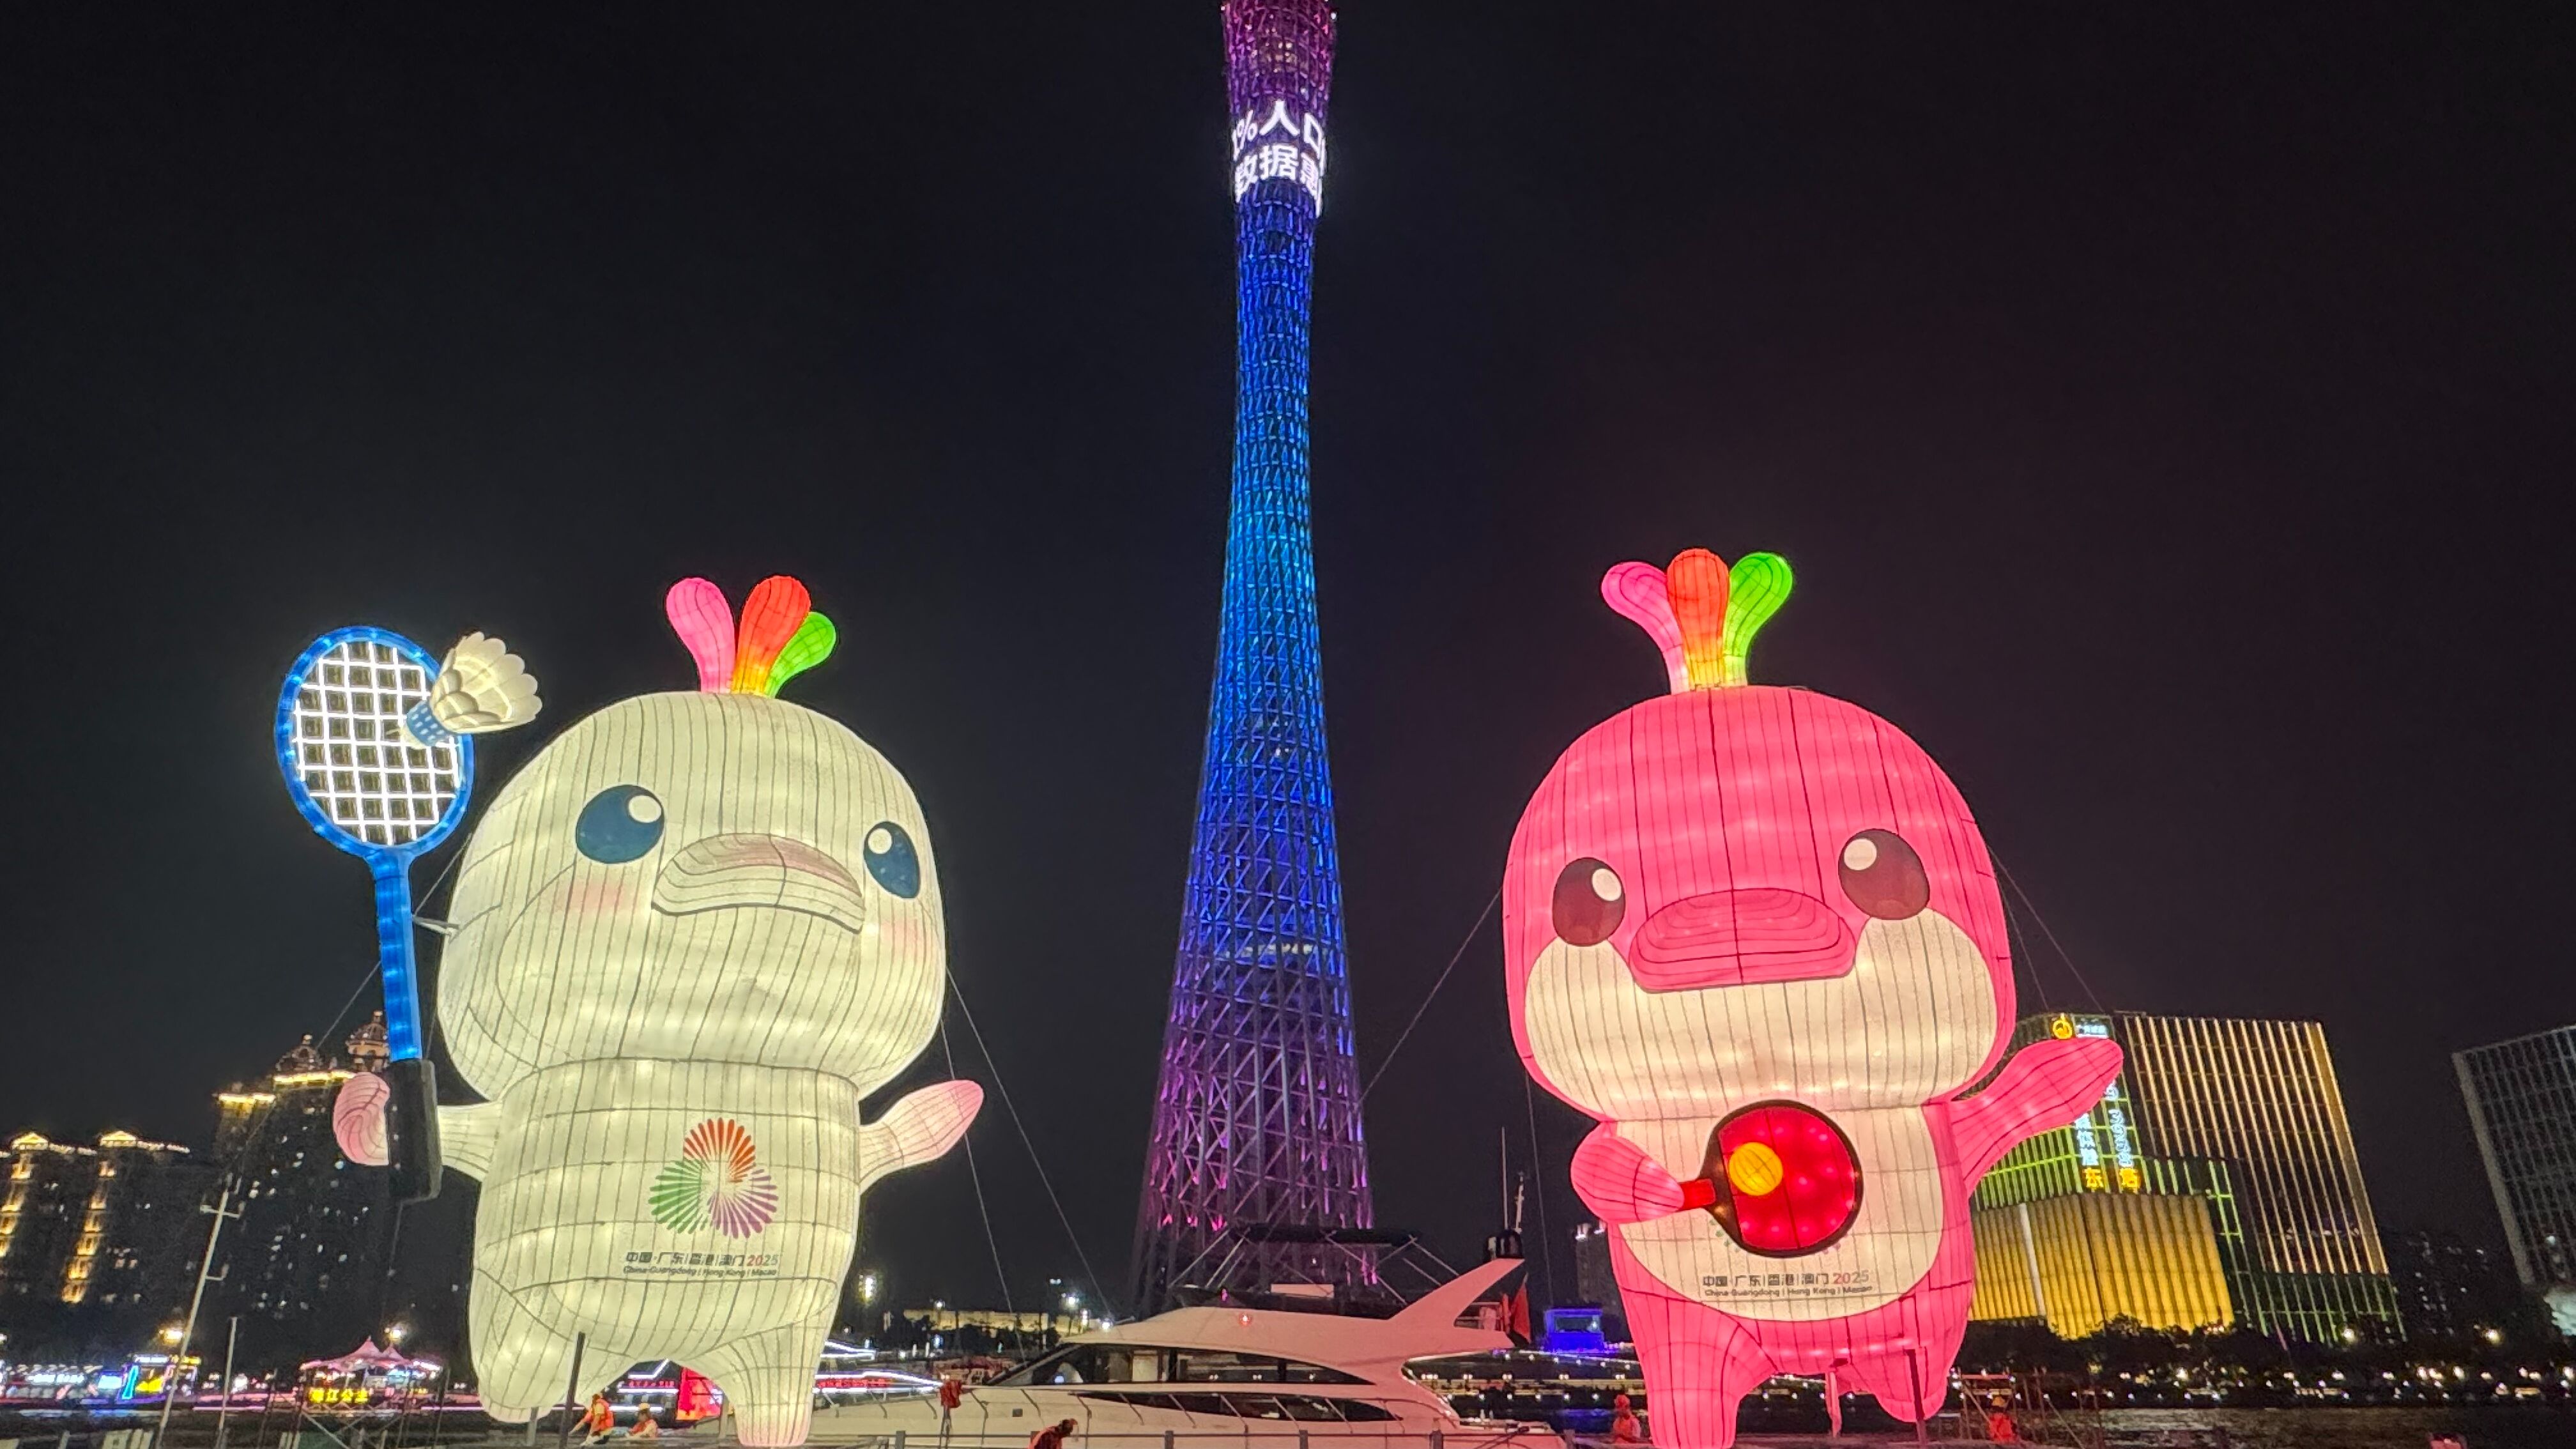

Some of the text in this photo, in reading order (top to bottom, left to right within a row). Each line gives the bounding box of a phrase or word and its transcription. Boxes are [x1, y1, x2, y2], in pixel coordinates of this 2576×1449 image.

[747, 1254, 779, 1267] 2025
[703, 1268, 724, 1278] Hong
[726, 1269, 746, 1278] Kong
[1832, 1269, 1869, 1284] 2025
